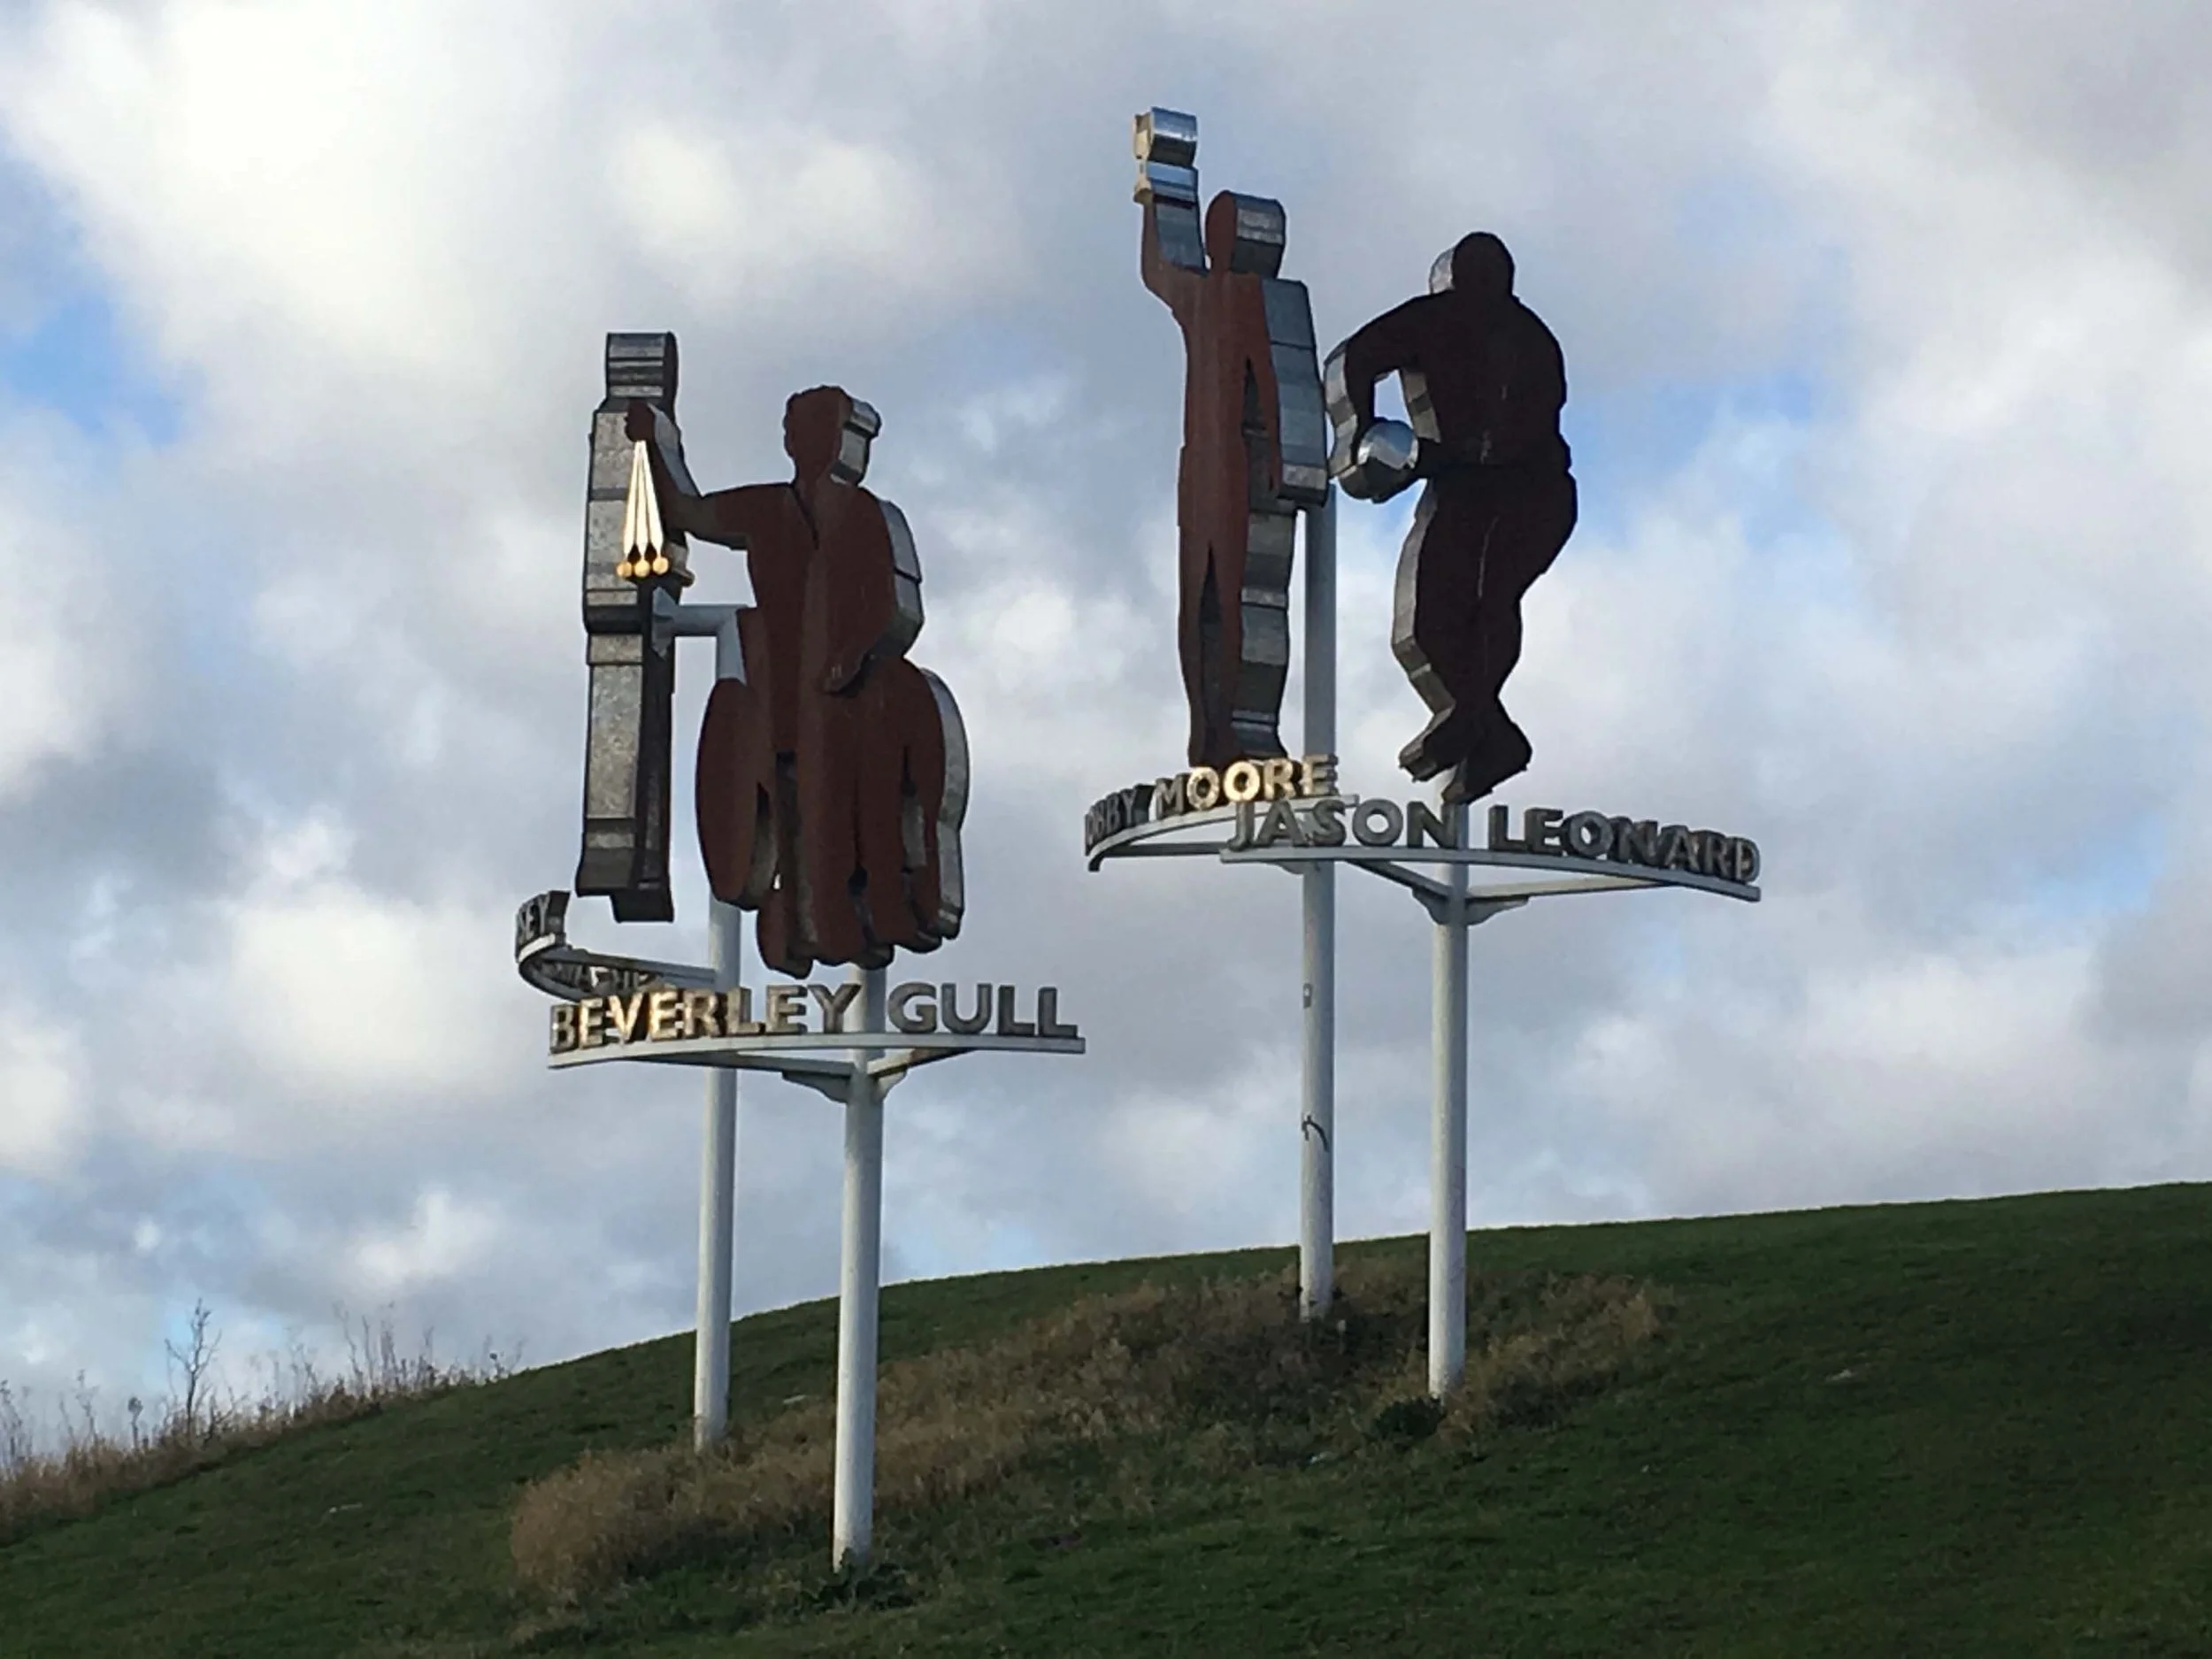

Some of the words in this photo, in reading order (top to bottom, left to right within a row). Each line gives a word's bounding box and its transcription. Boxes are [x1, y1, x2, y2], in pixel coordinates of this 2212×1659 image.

[1155, 754, 1338, 820] MOORE
[1227, 797, 1462, 851] JASON
[1488, 805, 1760, 884] LEONARD
[549, 983, 861, 1055] BEVERLEY
[887, 982, 1079, 1039] GULL
